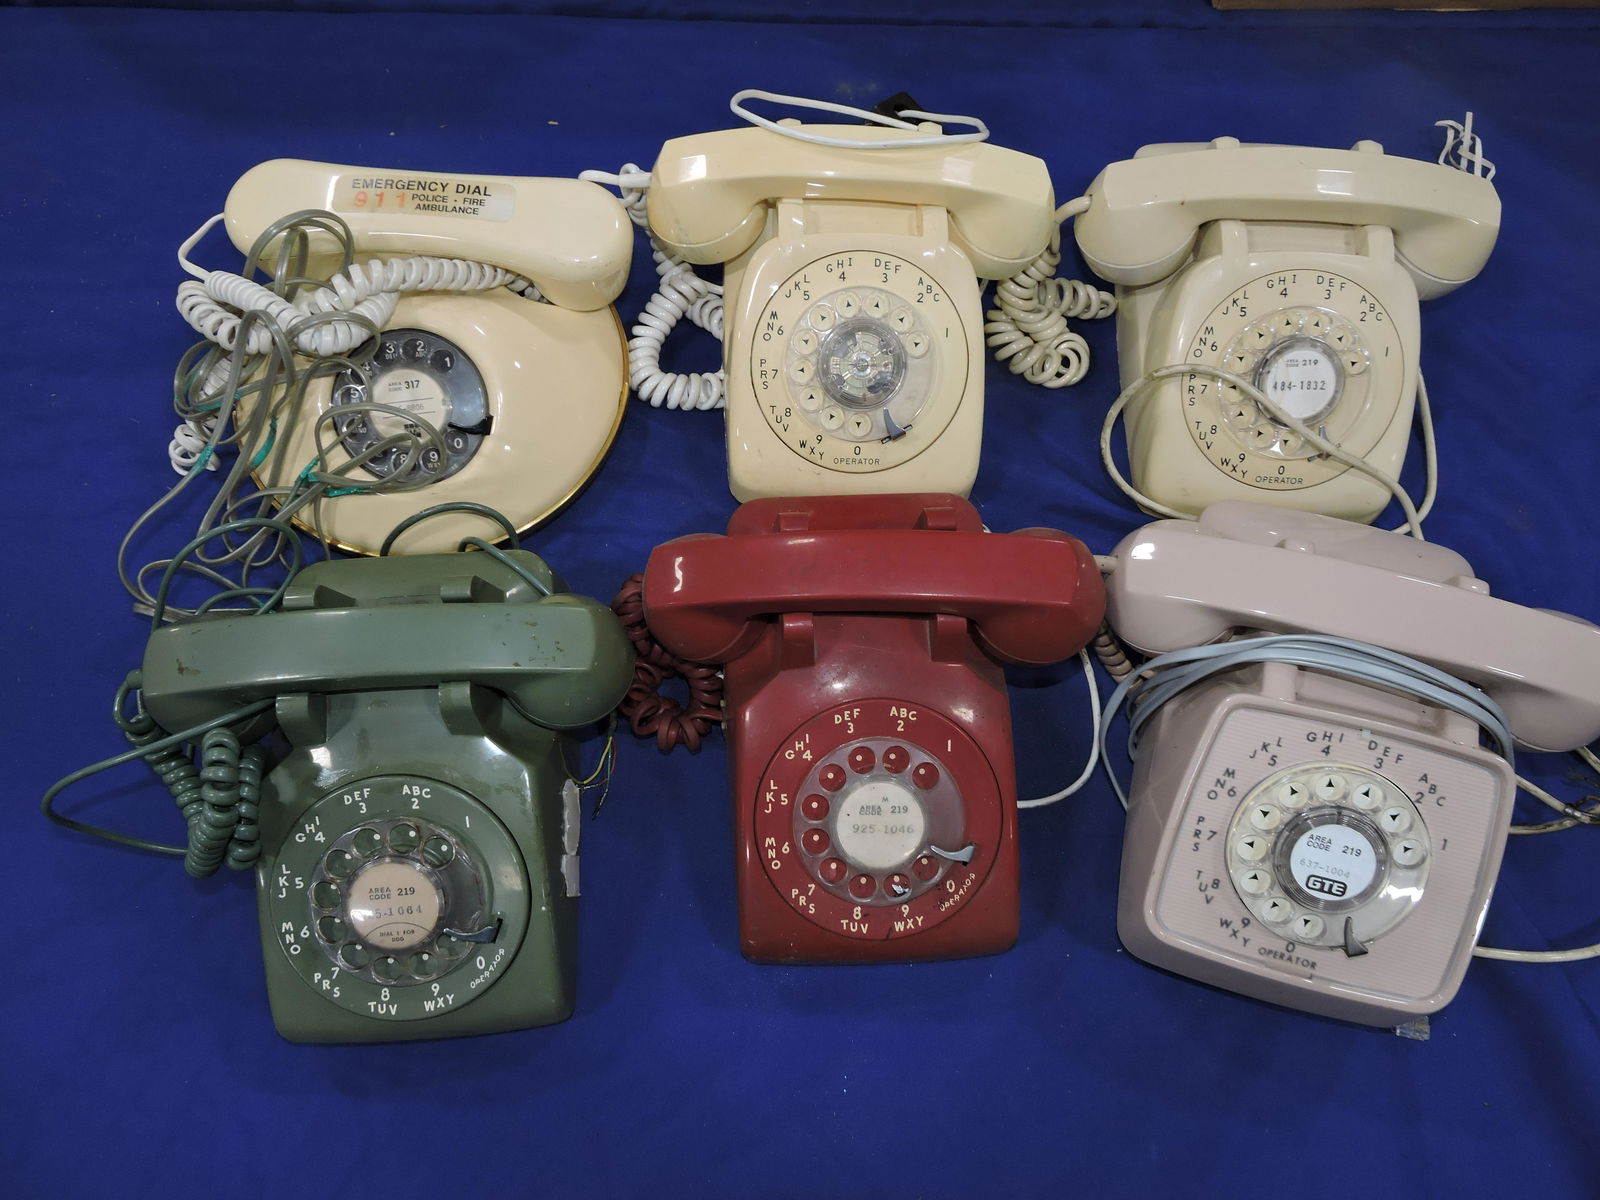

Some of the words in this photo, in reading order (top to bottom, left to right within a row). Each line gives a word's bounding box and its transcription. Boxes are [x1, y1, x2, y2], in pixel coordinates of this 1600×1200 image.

[352, 178, 449, 193] EMERGENCY
[455, 183, 492, 197] DIAL
[411, 193, 448, 203] POLICE
[463, 197, 486, 207] FIRE
[415, 203, 479, 215] AMBULANCE
[826, 258, 853, 273] GHI
[874, 259, 901, 273] DEF
[839, 272, 846, 281] 4
[882, 273, 888, 283] 3
[1267, 275, 1297, 288] GHI
[785, 274, 811, 298] JKL
[1316, 275, 1347, 291] DEF
[803, 291, 810, 300] 5
[917, 277, 940, 302] ABC
[1280, 288, 1289, 297] 4
[1324, 290, 1331, 299] 3
[917, 294, 924, 303] 2
[1222, 291, 1249, 315] JKL
[1240, 307, 1247, 316] 5
[1360, 295, 1383, 321] ABC
[1360, 312, 1366, 321] 2
[777, 326, 784, 335] 6
[386, 342, 395, 354] 3
[416, 341, 425, 351] 2
[1210, 342, 1218, 351] 6
[444, 357, 451, 368] 1
[1302, 359, 1319, 367] 219
[771, 369, 778, 379] 7
[404, 380, 420, 389] 317
[1200, 385, 1207, 395] 7
[1272, 380, 1326, 391] 484-1832
[350, 389, 359, 399] 5
[784, 407, 792, 417] 8
[769, 405, 789, 432] TUV
[1195, 421, 1213, 450] TUV
[1210, 425, 1218, 434] 8
[453, 438, 463, 449] 0
[816, 435, 823, 444] 9
[799, 440, 825, 460] WXY
[854, 446, 861, 456] 0
[429, 451, 439, 462] 9
[1238, 453, 1246, 463] 9
[1220, 458, 1248, 479] WXY
[1278, 465, 1285, 475] 0
[1255, 475, 1304, 485] OPERATOR
[835, 708, 861, 724] DEF
[890, 706, 917, 720] ABC
[847, 723, 854, 734] 3
[897, 720, 904, 731] 2
[1306, 731, 1344, 743] GHI
[785, 733, 809, 759] GHI
[947, 739, 952, 752] 1
[1248, 737, 1283, 759] JKL
[1321, 745, 1331, 756] 4
[802, 750, 813, 761] 4
[1368, 740, 1404, 764] DEF
[1268, 755, 1277, 767] 5
[1375, 757, 1384, 769] 3
[402, 784, 431, 798] ABC
[1227, 785, 1236, 798] 6
[1418, 773, 1446, 807] ABC
[344, 788, 371, 805] DEF
[780, 794, 788, 805] 5
[1414, 791, 1424, 805] 2
[359, 803, 367, 814] 3
[411, 798, 420, 810] 2
[890, 805, 909, 814] 219
[465, 816, 470, 828] 1
[295, 816, 320, 843] GHI
[314, 832, 326, 843] 4
[1207, 831, 1217, 841] 7
[1308, 834, 1332, 845] AREA
[782, 841, 790, 853] 6
[1306, 840, 1331, 852] CODE
[1342, 845, 1362, 857] 219
[1441, 839, 1447, 850] 1
[1299, 858, 1350, 879] 637-1004
[295, 878, 304, 889] 5
[946, 880, 956, 892] 0
[1211, 878, 1220, 890] 8
[1306, 875, 1347, 897] GTE
[368, 886, 391, 894] AREA
[397, 887, 415, 896] 219
[807, 884, 815, 896] 7
[792, 889, 816, 913] PRS
[853, 907, 862, 919] 8
[901, 904, 910, 917] 9
[841, 920, 868, 934] TUV
[894, 916, 923, 932] WXY
[1242, 917, 1250, 928] 9
[300, 926, 309, 939] 6
[1219, 918, 1250, 947] WXY
[1286, 942, 1296, 953] 0
[476, 956, 485, 969] 0
[1258, 947, 1317, 970] OPERATOR
[331, 967, 340, 979] 7
[314, 972, 341, 998] PRS
[431, 983, 440, 996] 9
[381, 988, 390, 1001] 8
[368, 1002, 398, 1015] TUV
[424, 994, 455, 1012] WXY
